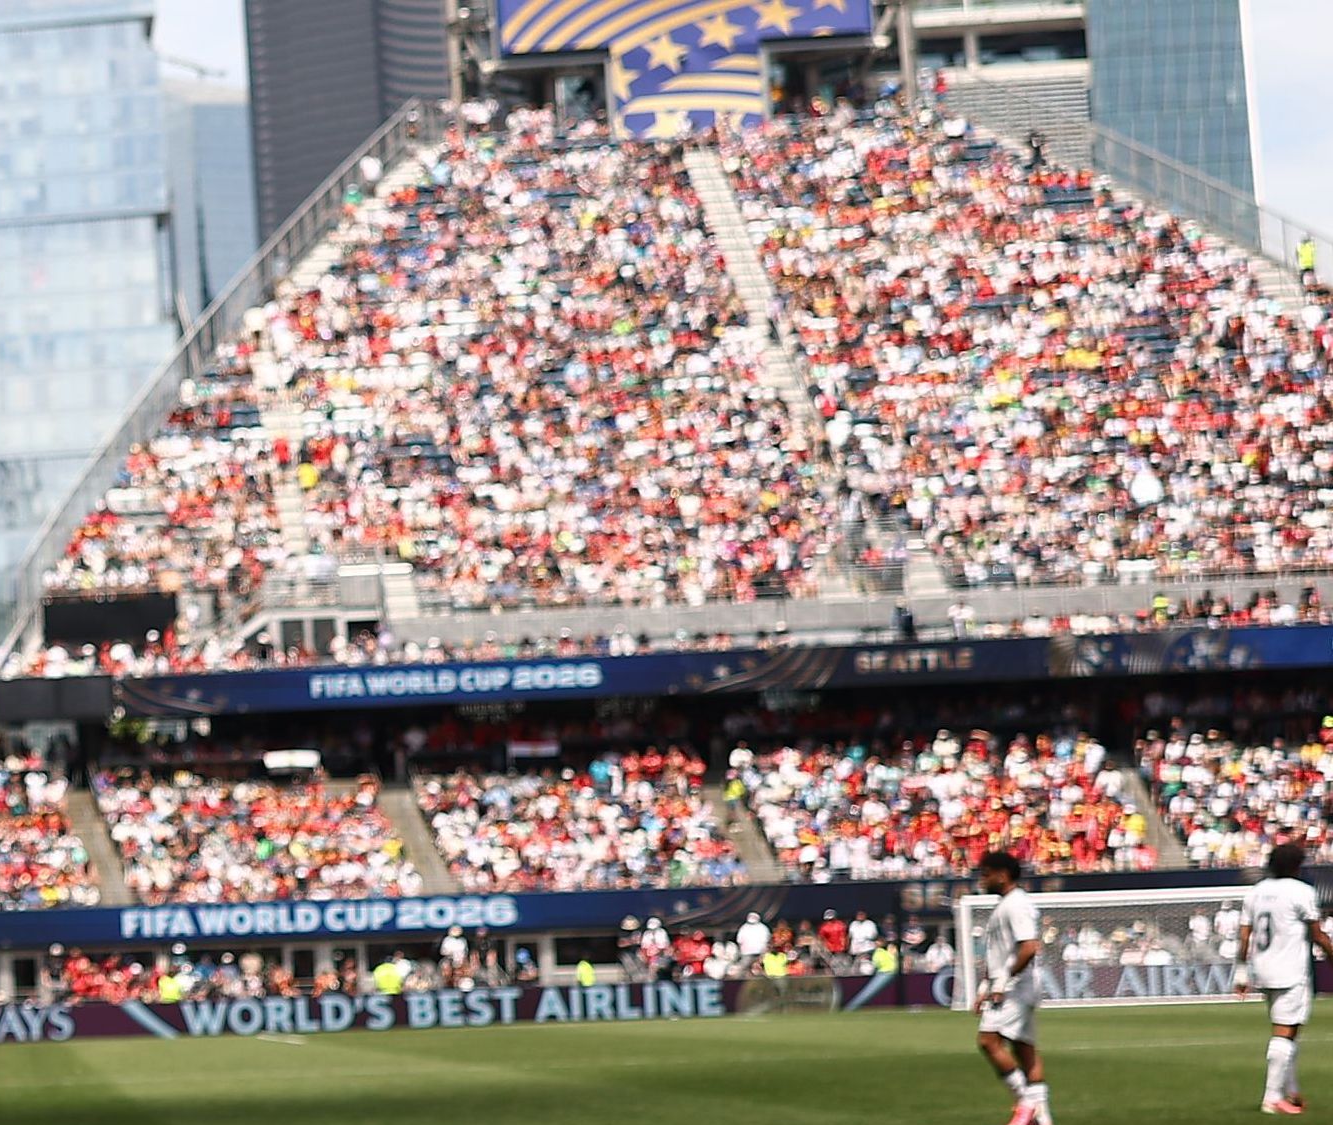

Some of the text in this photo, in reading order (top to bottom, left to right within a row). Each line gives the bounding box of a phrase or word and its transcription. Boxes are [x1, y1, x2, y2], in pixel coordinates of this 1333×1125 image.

[854, 647, 973, 674] SEATTLE
[308, 662, 603, 699] FIFA WORLD CUP 2026
[119, 895, 519, 938] FIFA WORLD CUP 2026
[1115, 963, 1236, 998] AIRW
[182, 979, 726, 1037] WORLD'S BEST AIRLINE
